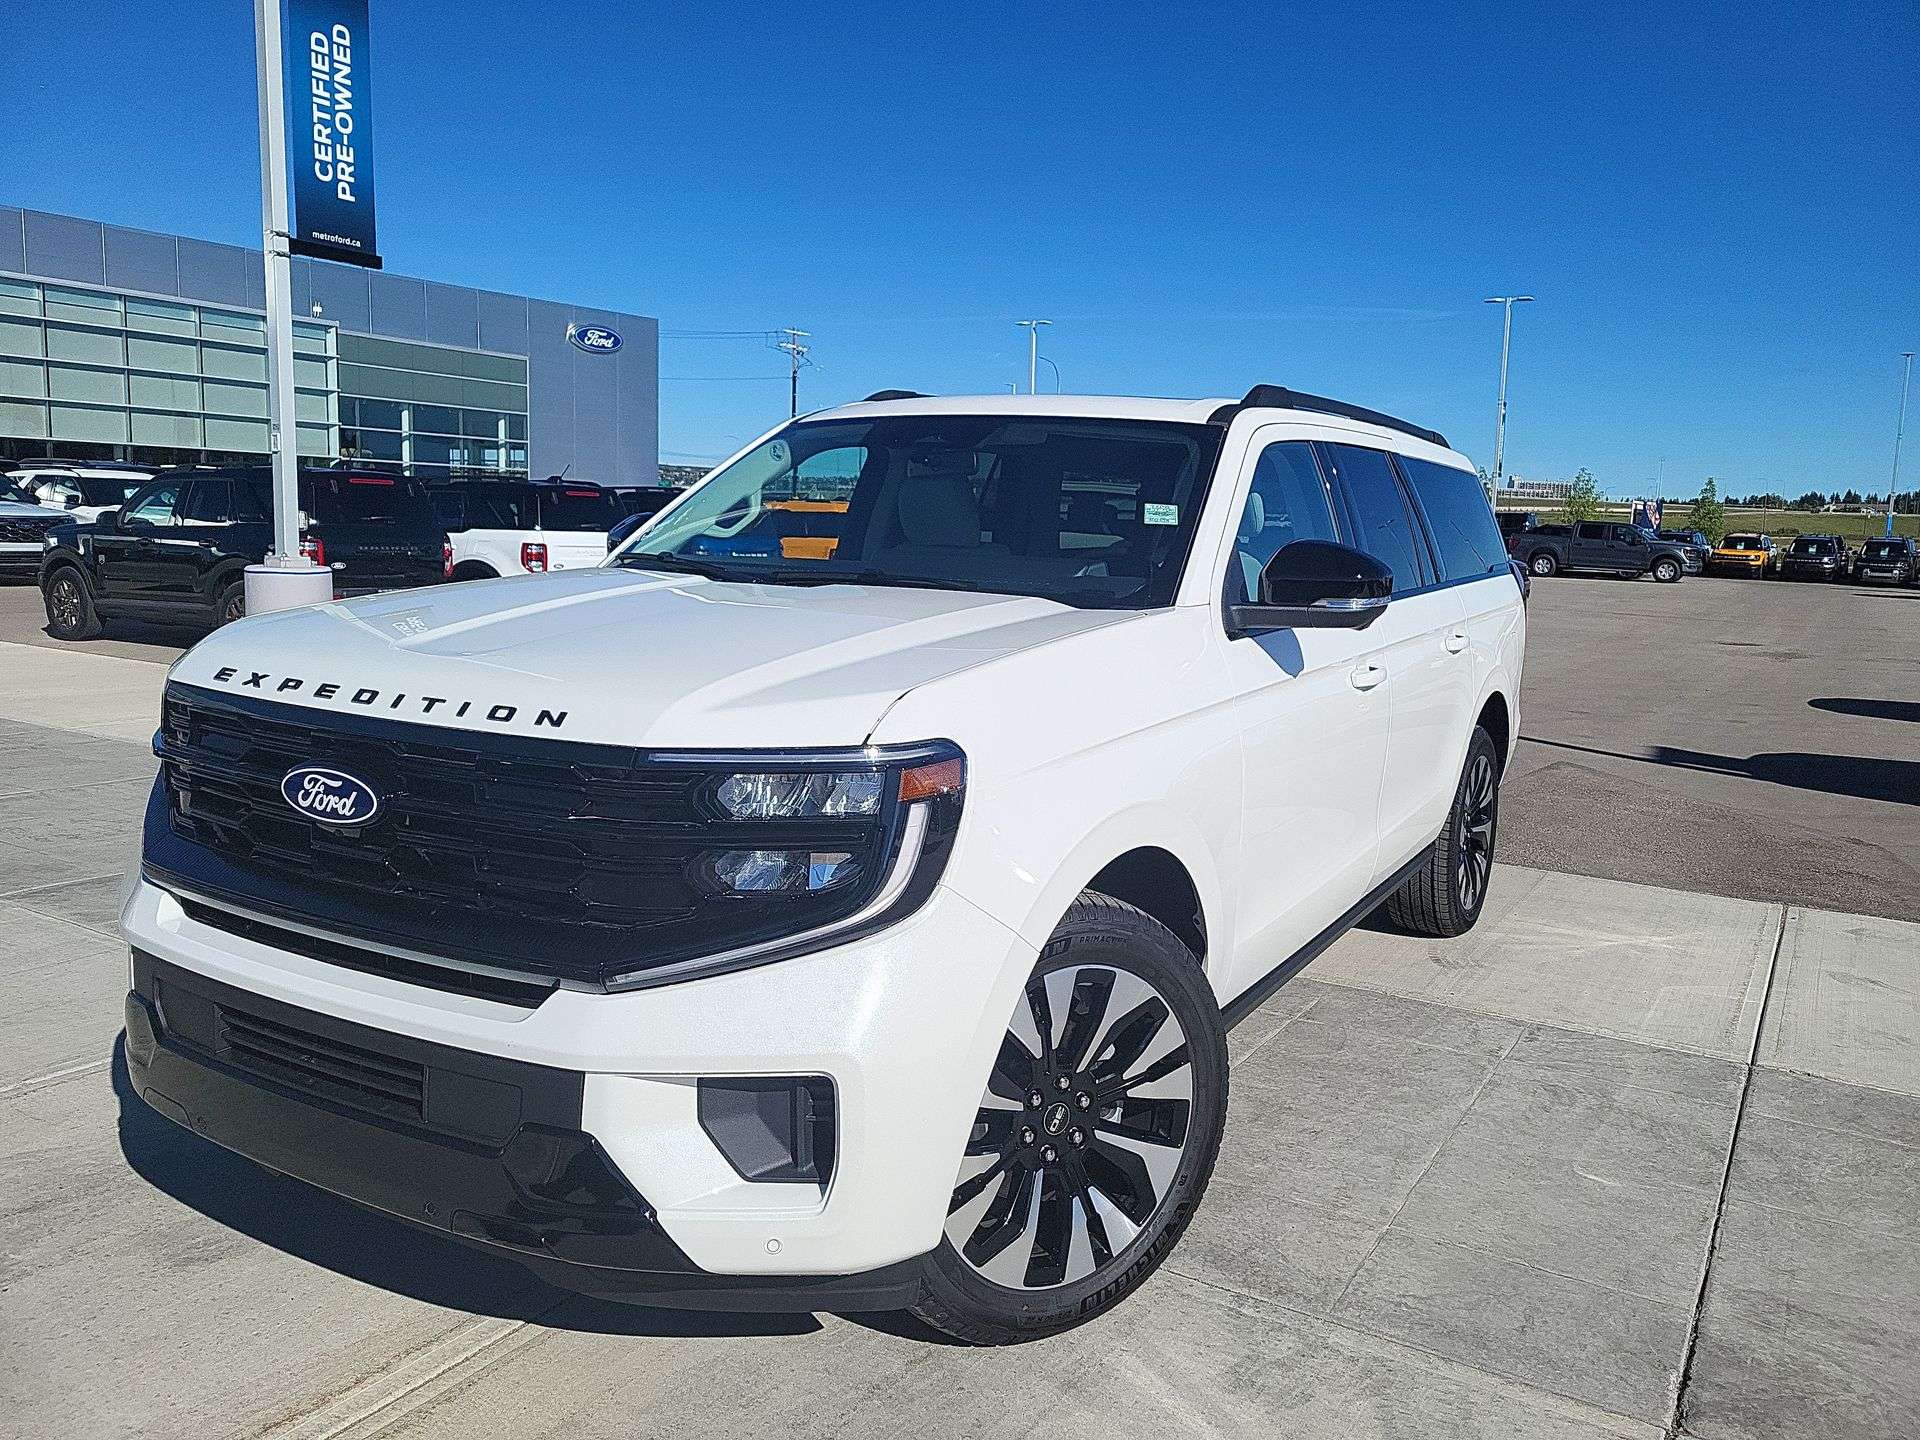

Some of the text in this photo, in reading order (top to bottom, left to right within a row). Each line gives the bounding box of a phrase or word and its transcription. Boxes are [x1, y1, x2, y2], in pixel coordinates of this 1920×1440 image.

[310, 31, 334, 183] CERTIFIED
[332, 23, 356, 203] PRE-OWNED
[312, 231, 361, 248] metroford.ca
[584, 329, 616, 348] Ford
[213, 666, 569, 728] EXPEDITION
[297, 773, 358, 817] Ford
